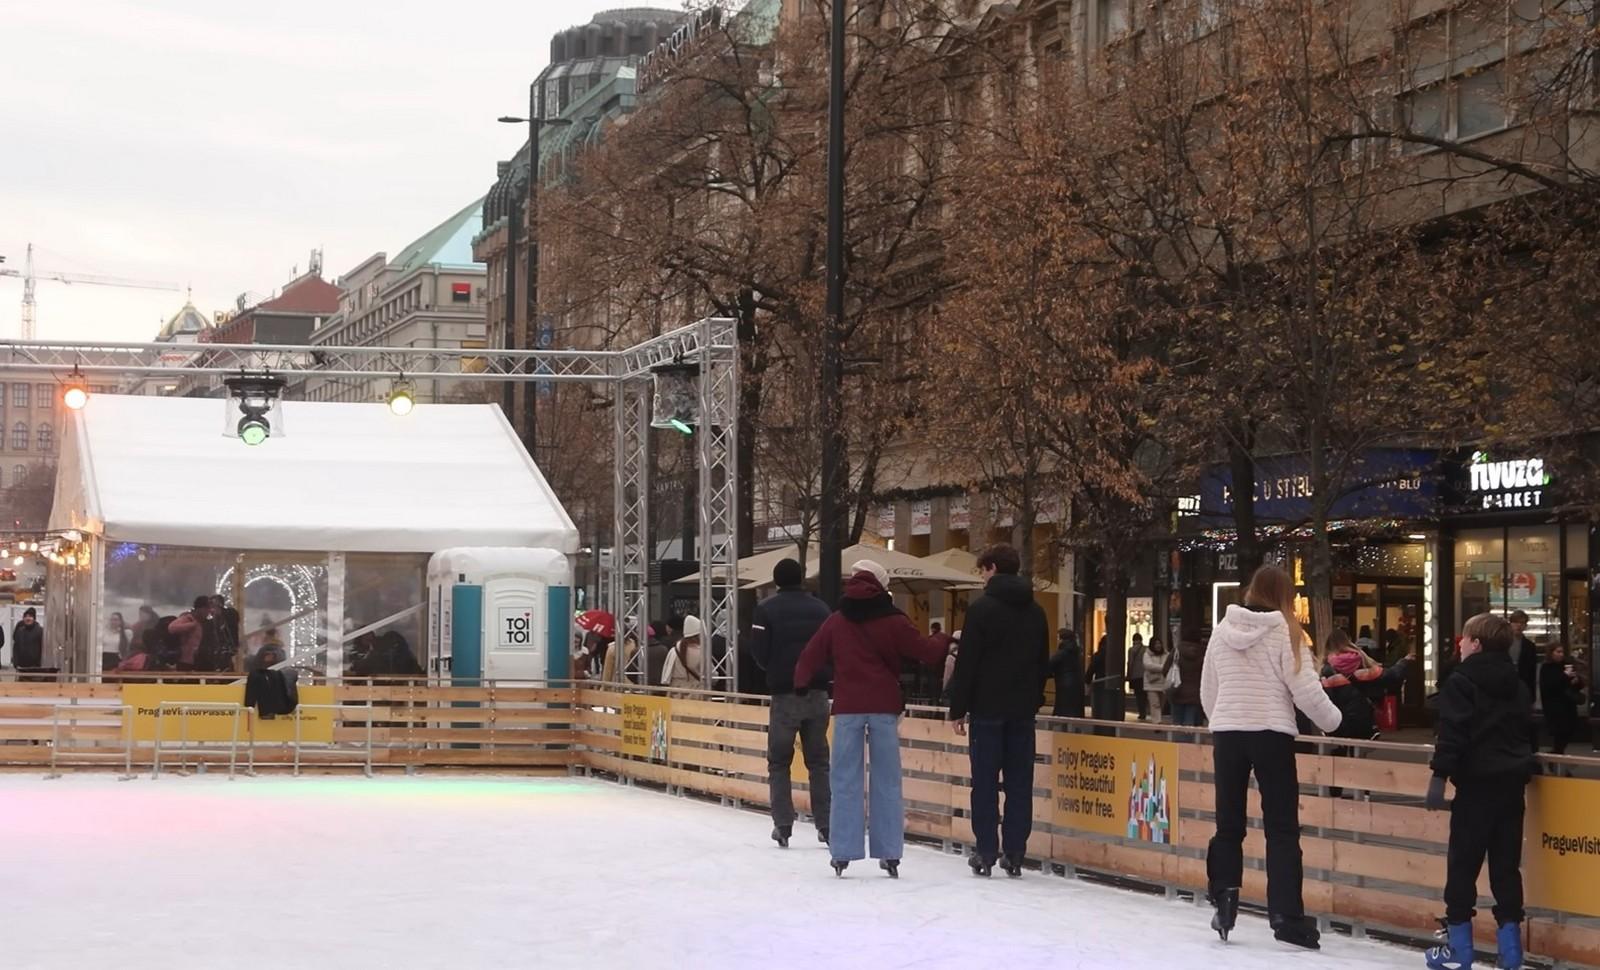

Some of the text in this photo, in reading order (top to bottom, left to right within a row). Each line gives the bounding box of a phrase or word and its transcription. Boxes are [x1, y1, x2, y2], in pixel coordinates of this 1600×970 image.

[506, 631, 530, 643] TOI
[1058, 748, 1115, 773] Enjoy Prague's
[1057, 772, 1116, 794] most beautiful
[1057, 793, 1115, 818] views for free.
